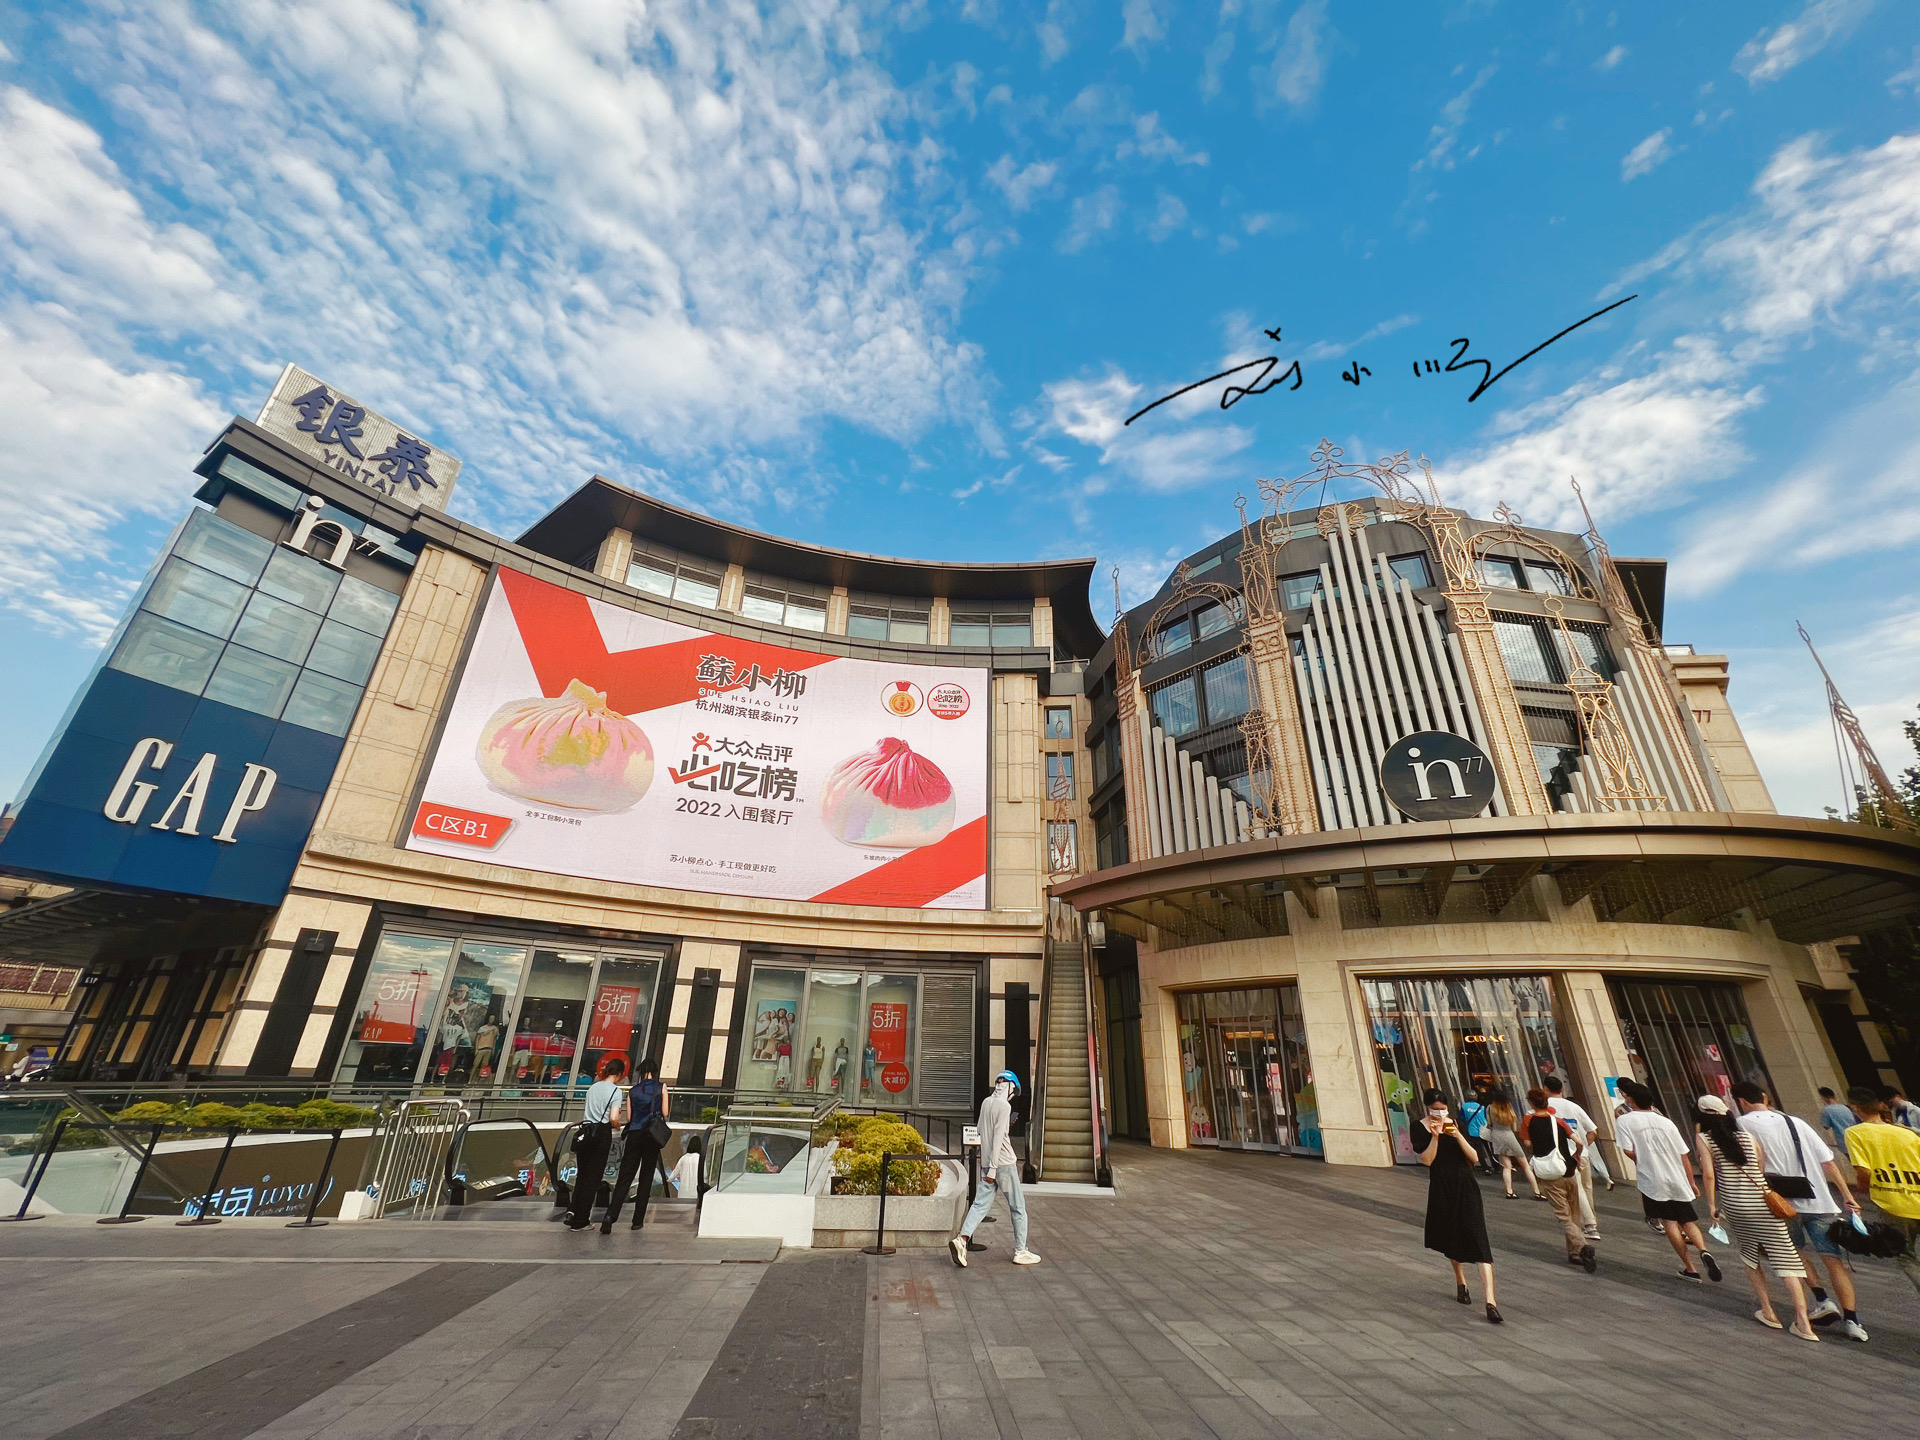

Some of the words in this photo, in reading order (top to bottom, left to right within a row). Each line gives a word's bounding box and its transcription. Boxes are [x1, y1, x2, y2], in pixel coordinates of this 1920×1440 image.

[291, 385, 438, 491] 银泰
[324, 448, 396, 496] YINTAI
[695, 699, 799, 725] 杭州湖滨银泰in77
[698, 688, 723, 698] SUE
[731, 694, 771, 707] HSIAO
[779, 703, 799, 712] LIU
[714, 737, 793, 763] 大众点评
[104, 737, 278, 843] GAP
[667, 753, 798, 802] 必吃榜
[675, 798, 721, 817] 2022
[724, 804, 794, 825] 入围餐厅
[425, 813, 488, 839] C区B1
[378, 979, 421, 1002] 5折
[597, 992, 632, 1014] 5折
[872, 1010, 902, 1028] 5折
[363, 1027, 383, 1039] GAP
[589, 1035, 604, 1047] GAP
[884, 1076, 907, 1085] 大减价
